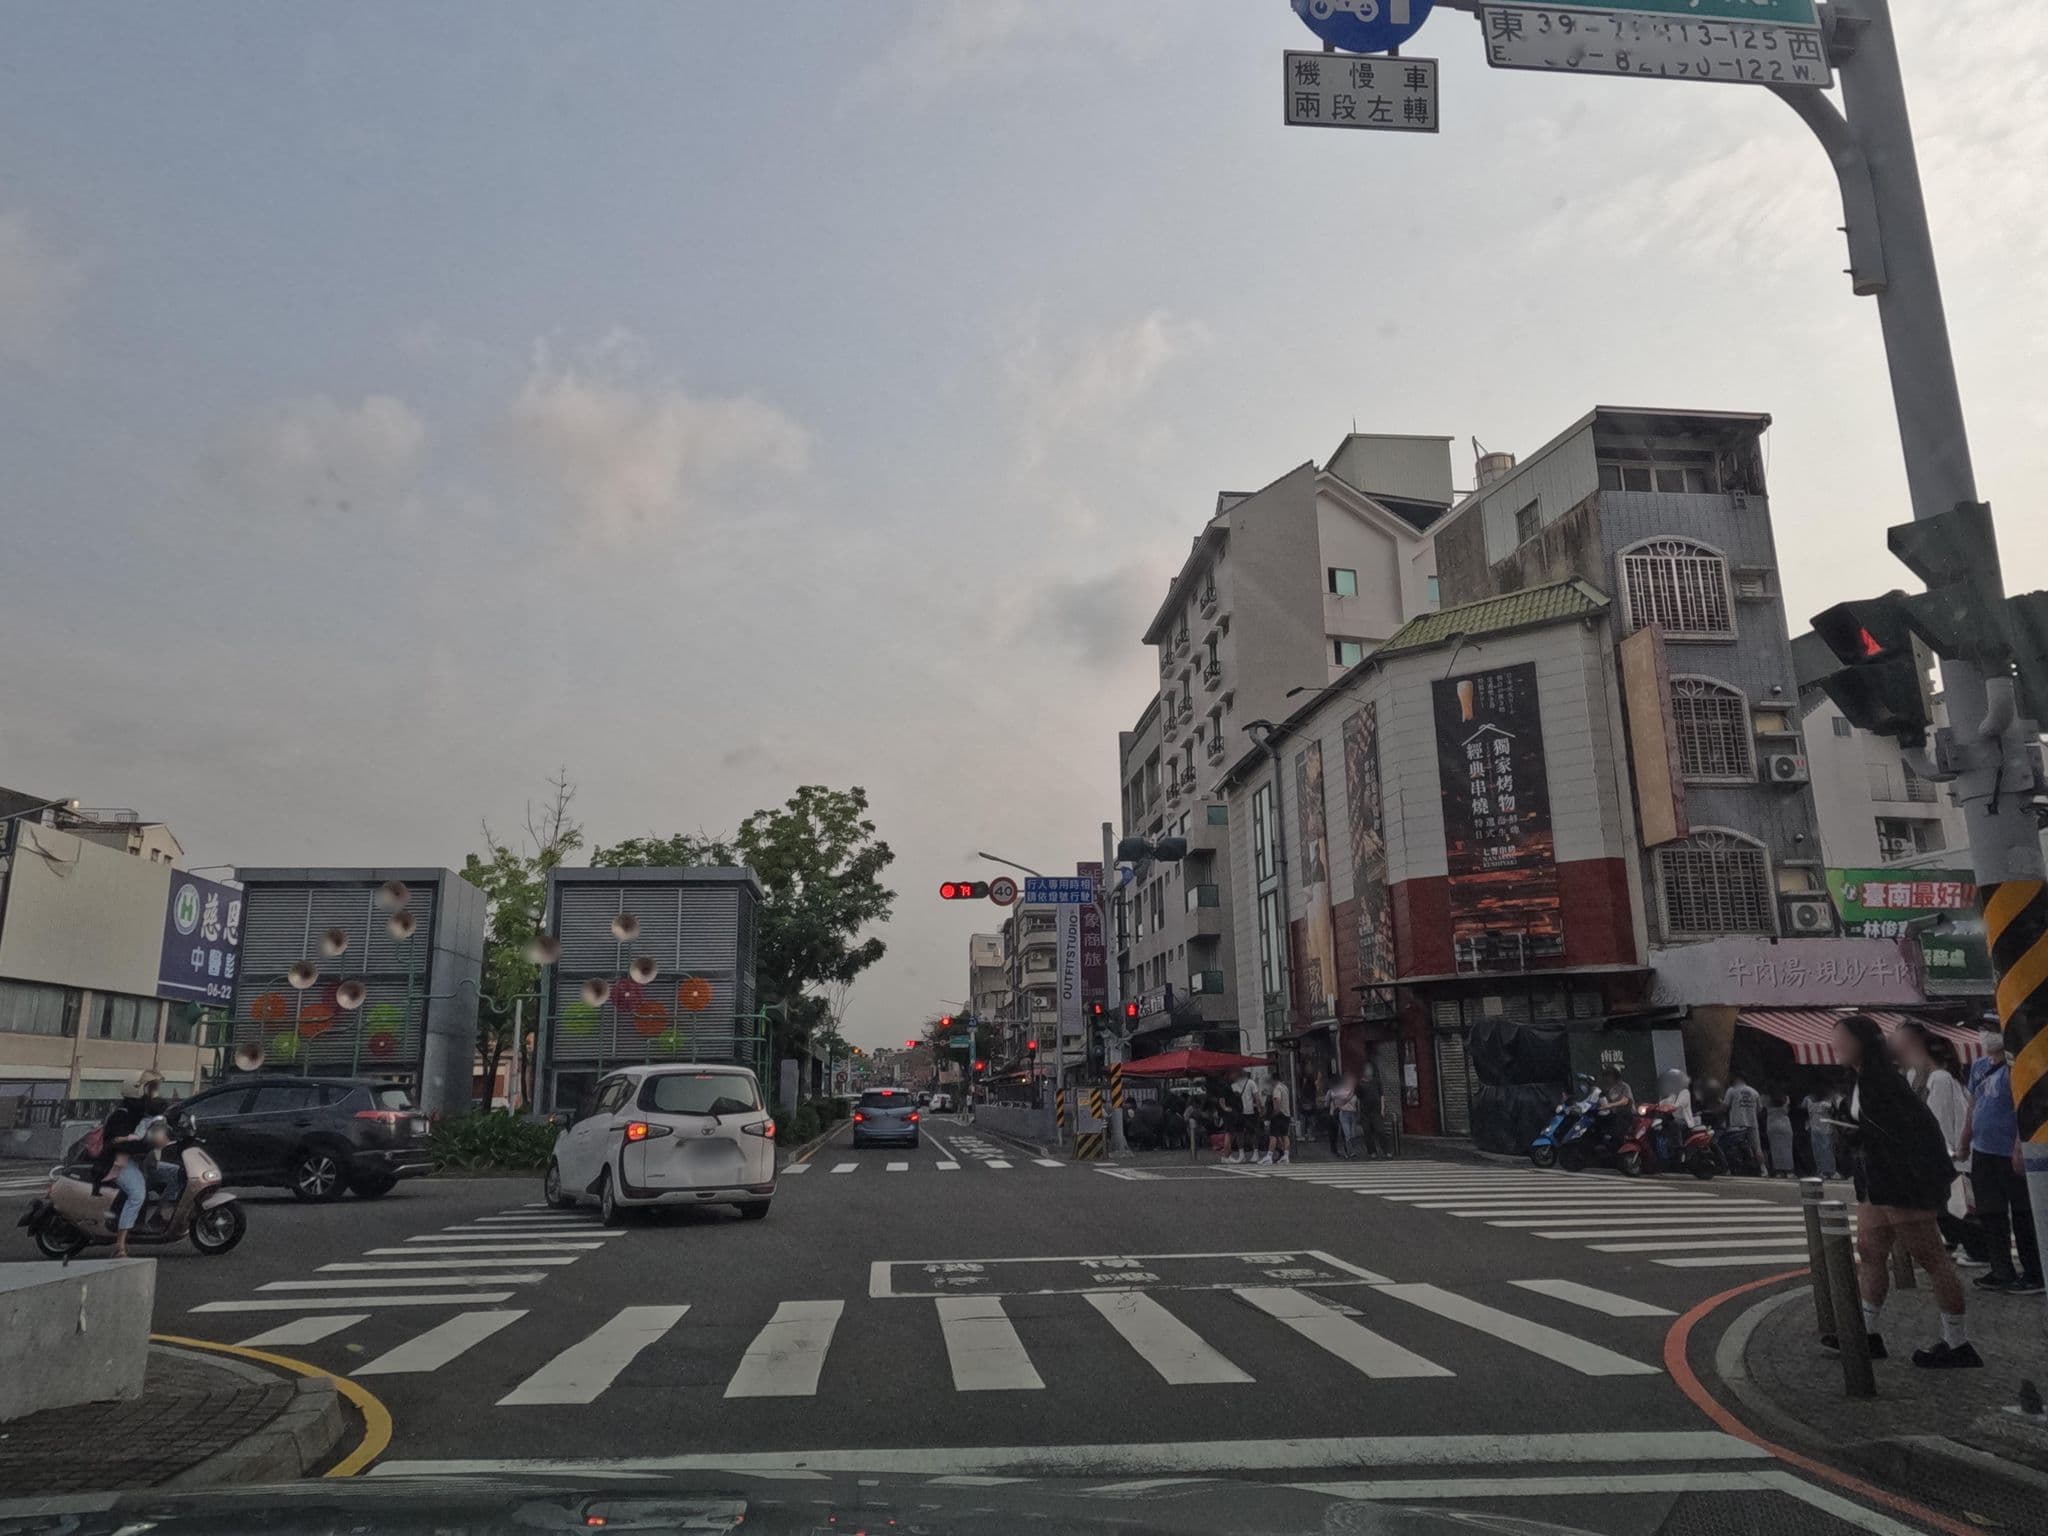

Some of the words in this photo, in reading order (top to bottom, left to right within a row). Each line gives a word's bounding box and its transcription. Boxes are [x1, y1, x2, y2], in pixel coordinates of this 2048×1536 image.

[1488, 11, 1523, 42] 東
[1785, 31, 1822, 62] 西
[1295, 60, 1429, 92] 機慢車
[1294, 91, 1429, 124] 兩段左轉
[1466, 742, 1489, 816] 經典串燒
[1493, 737, 1516, 812] 獨家烤物
[994, 886, 1012, 897] 40
[1027, 879, 1091, 890] 行人專用時相
[1083, 903, 1101, 967] 象商旅
